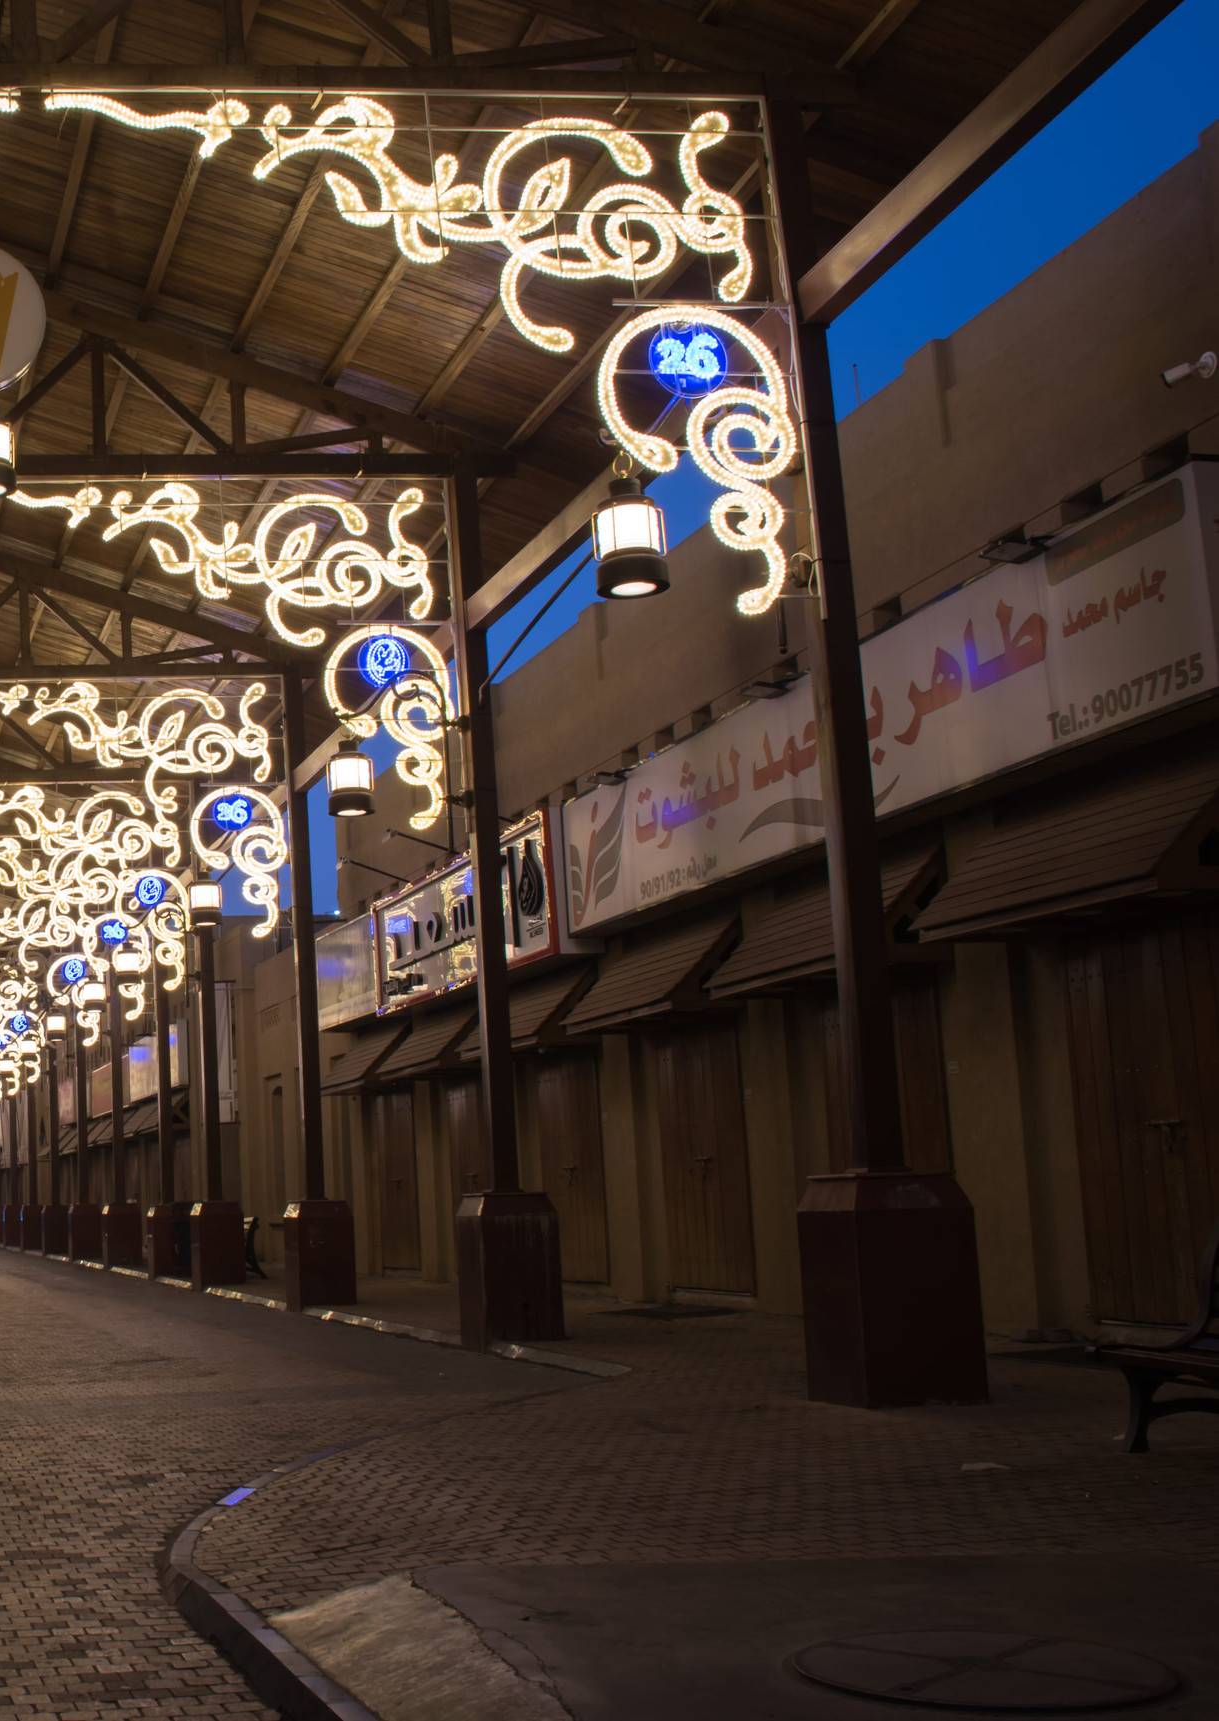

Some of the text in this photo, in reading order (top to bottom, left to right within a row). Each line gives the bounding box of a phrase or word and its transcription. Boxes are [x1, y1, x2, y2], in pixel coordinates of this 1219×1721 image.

[655, 332, 720, 380] 26
[1063, 566, 1167, 639] جاسم محمد
[894, 598, 1048, 746] طاهر
[216, 799, 248, 824] 26
[635, 744, 741, 850] للبشوت
